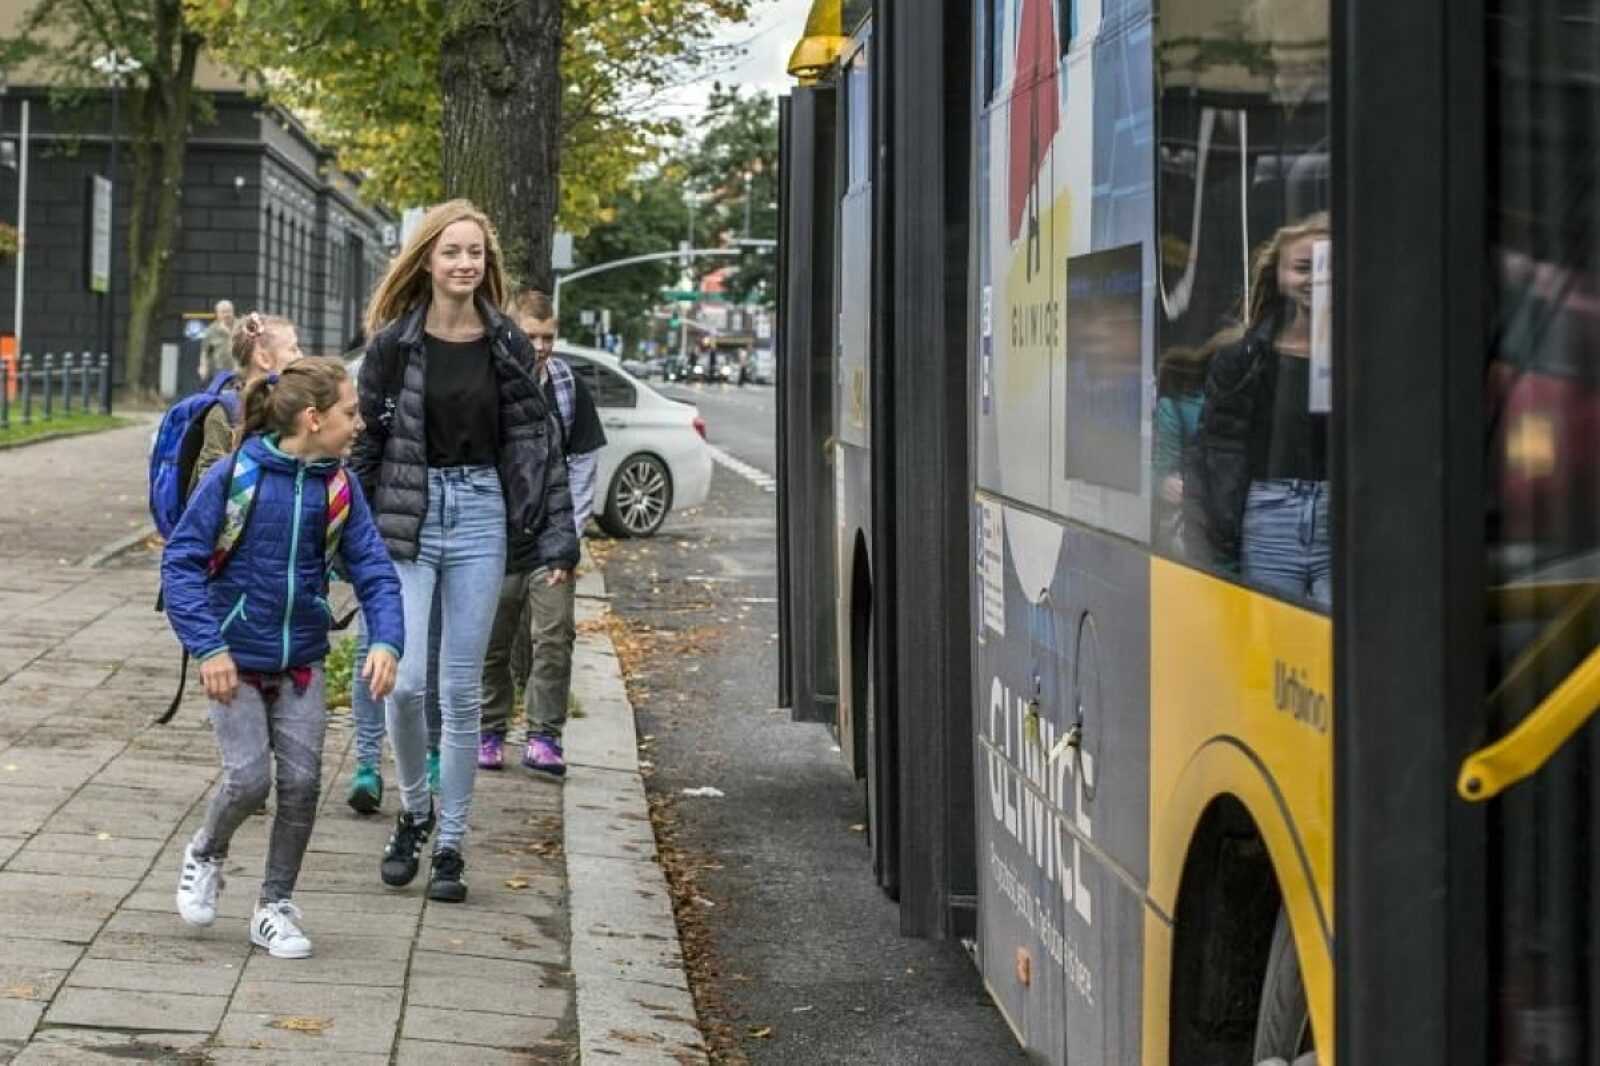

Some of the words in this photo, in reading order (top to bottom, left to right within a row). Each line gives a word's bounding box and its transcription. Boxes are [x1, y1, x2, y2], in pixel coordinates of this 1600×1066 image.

[1011, 301, 1059, 348] GLIWICE
[1275, 658, 1328, 735] Urbino
[988, 675, 1094, 927] GLIWICE
